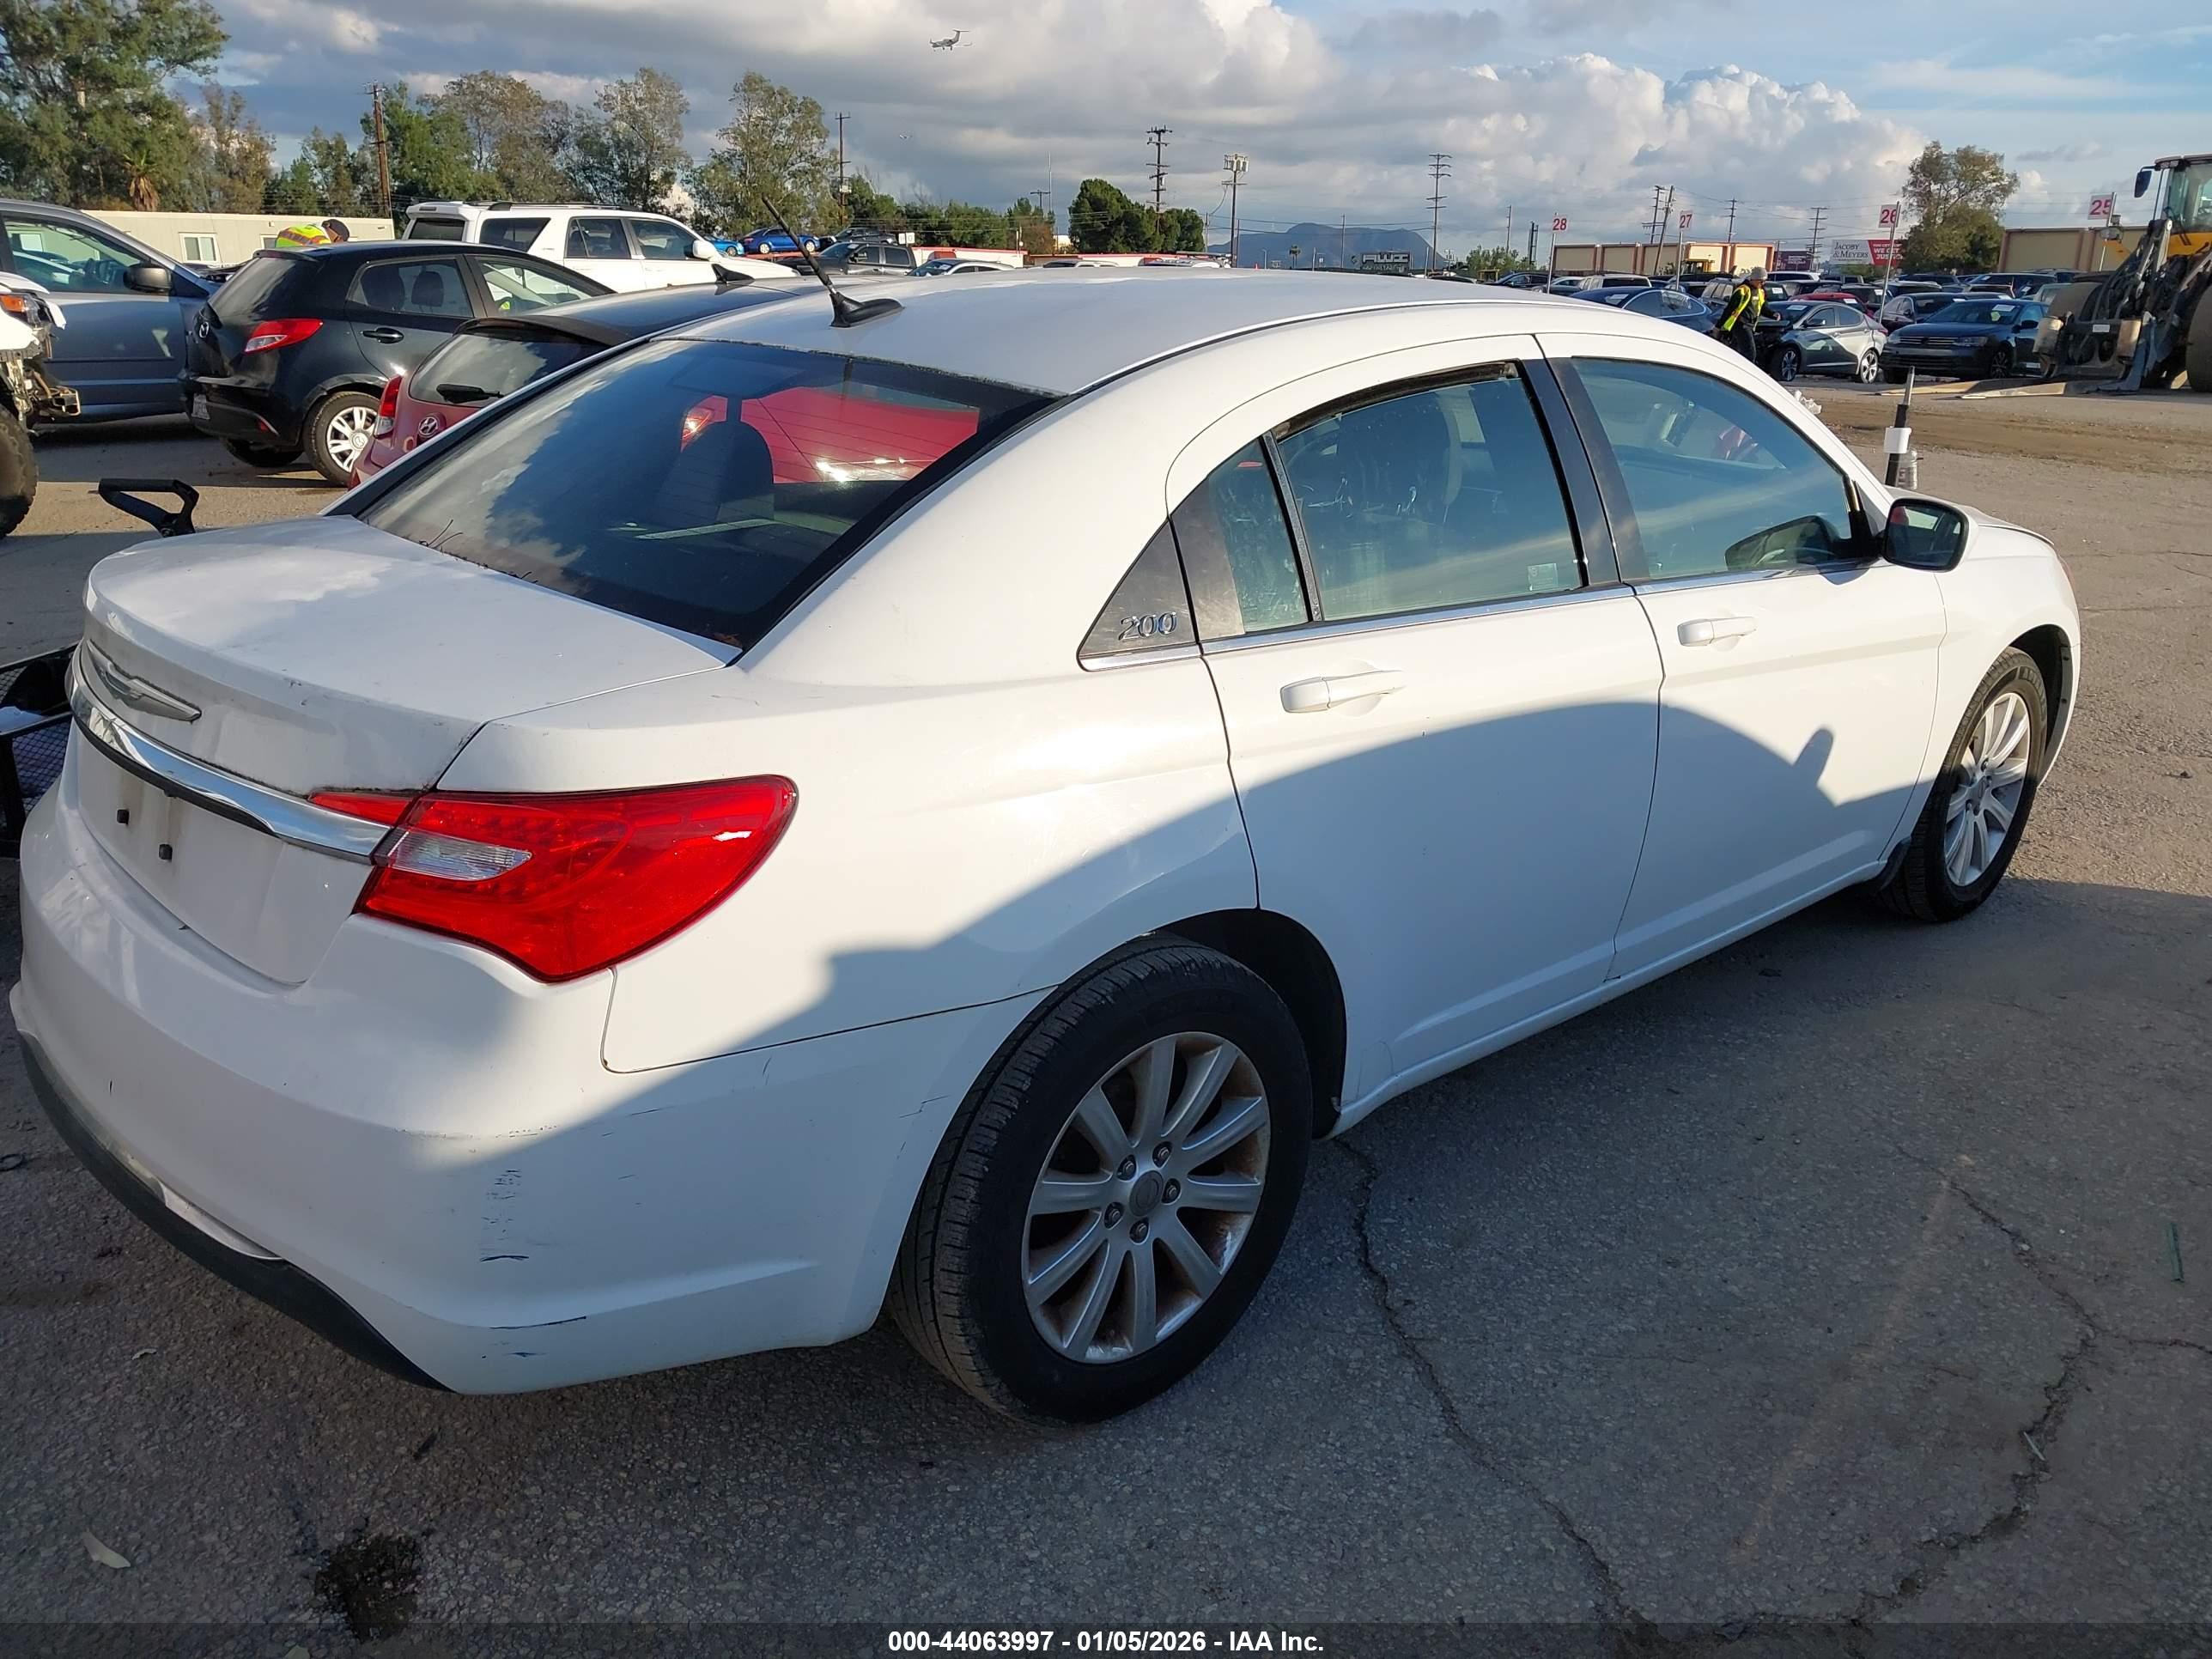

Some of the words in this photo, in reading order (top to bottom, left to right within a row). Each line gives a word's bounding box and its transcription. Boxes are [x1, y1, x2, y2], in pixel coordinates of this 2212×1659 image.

[2090, 199, 2112, 215] 25
[1680, 214, 1692, 228] 27
[1881, 209, 1897, 223] 26
[1553, 218, 1567, 231] 28
[1118, 611, 1177, 641] 200
